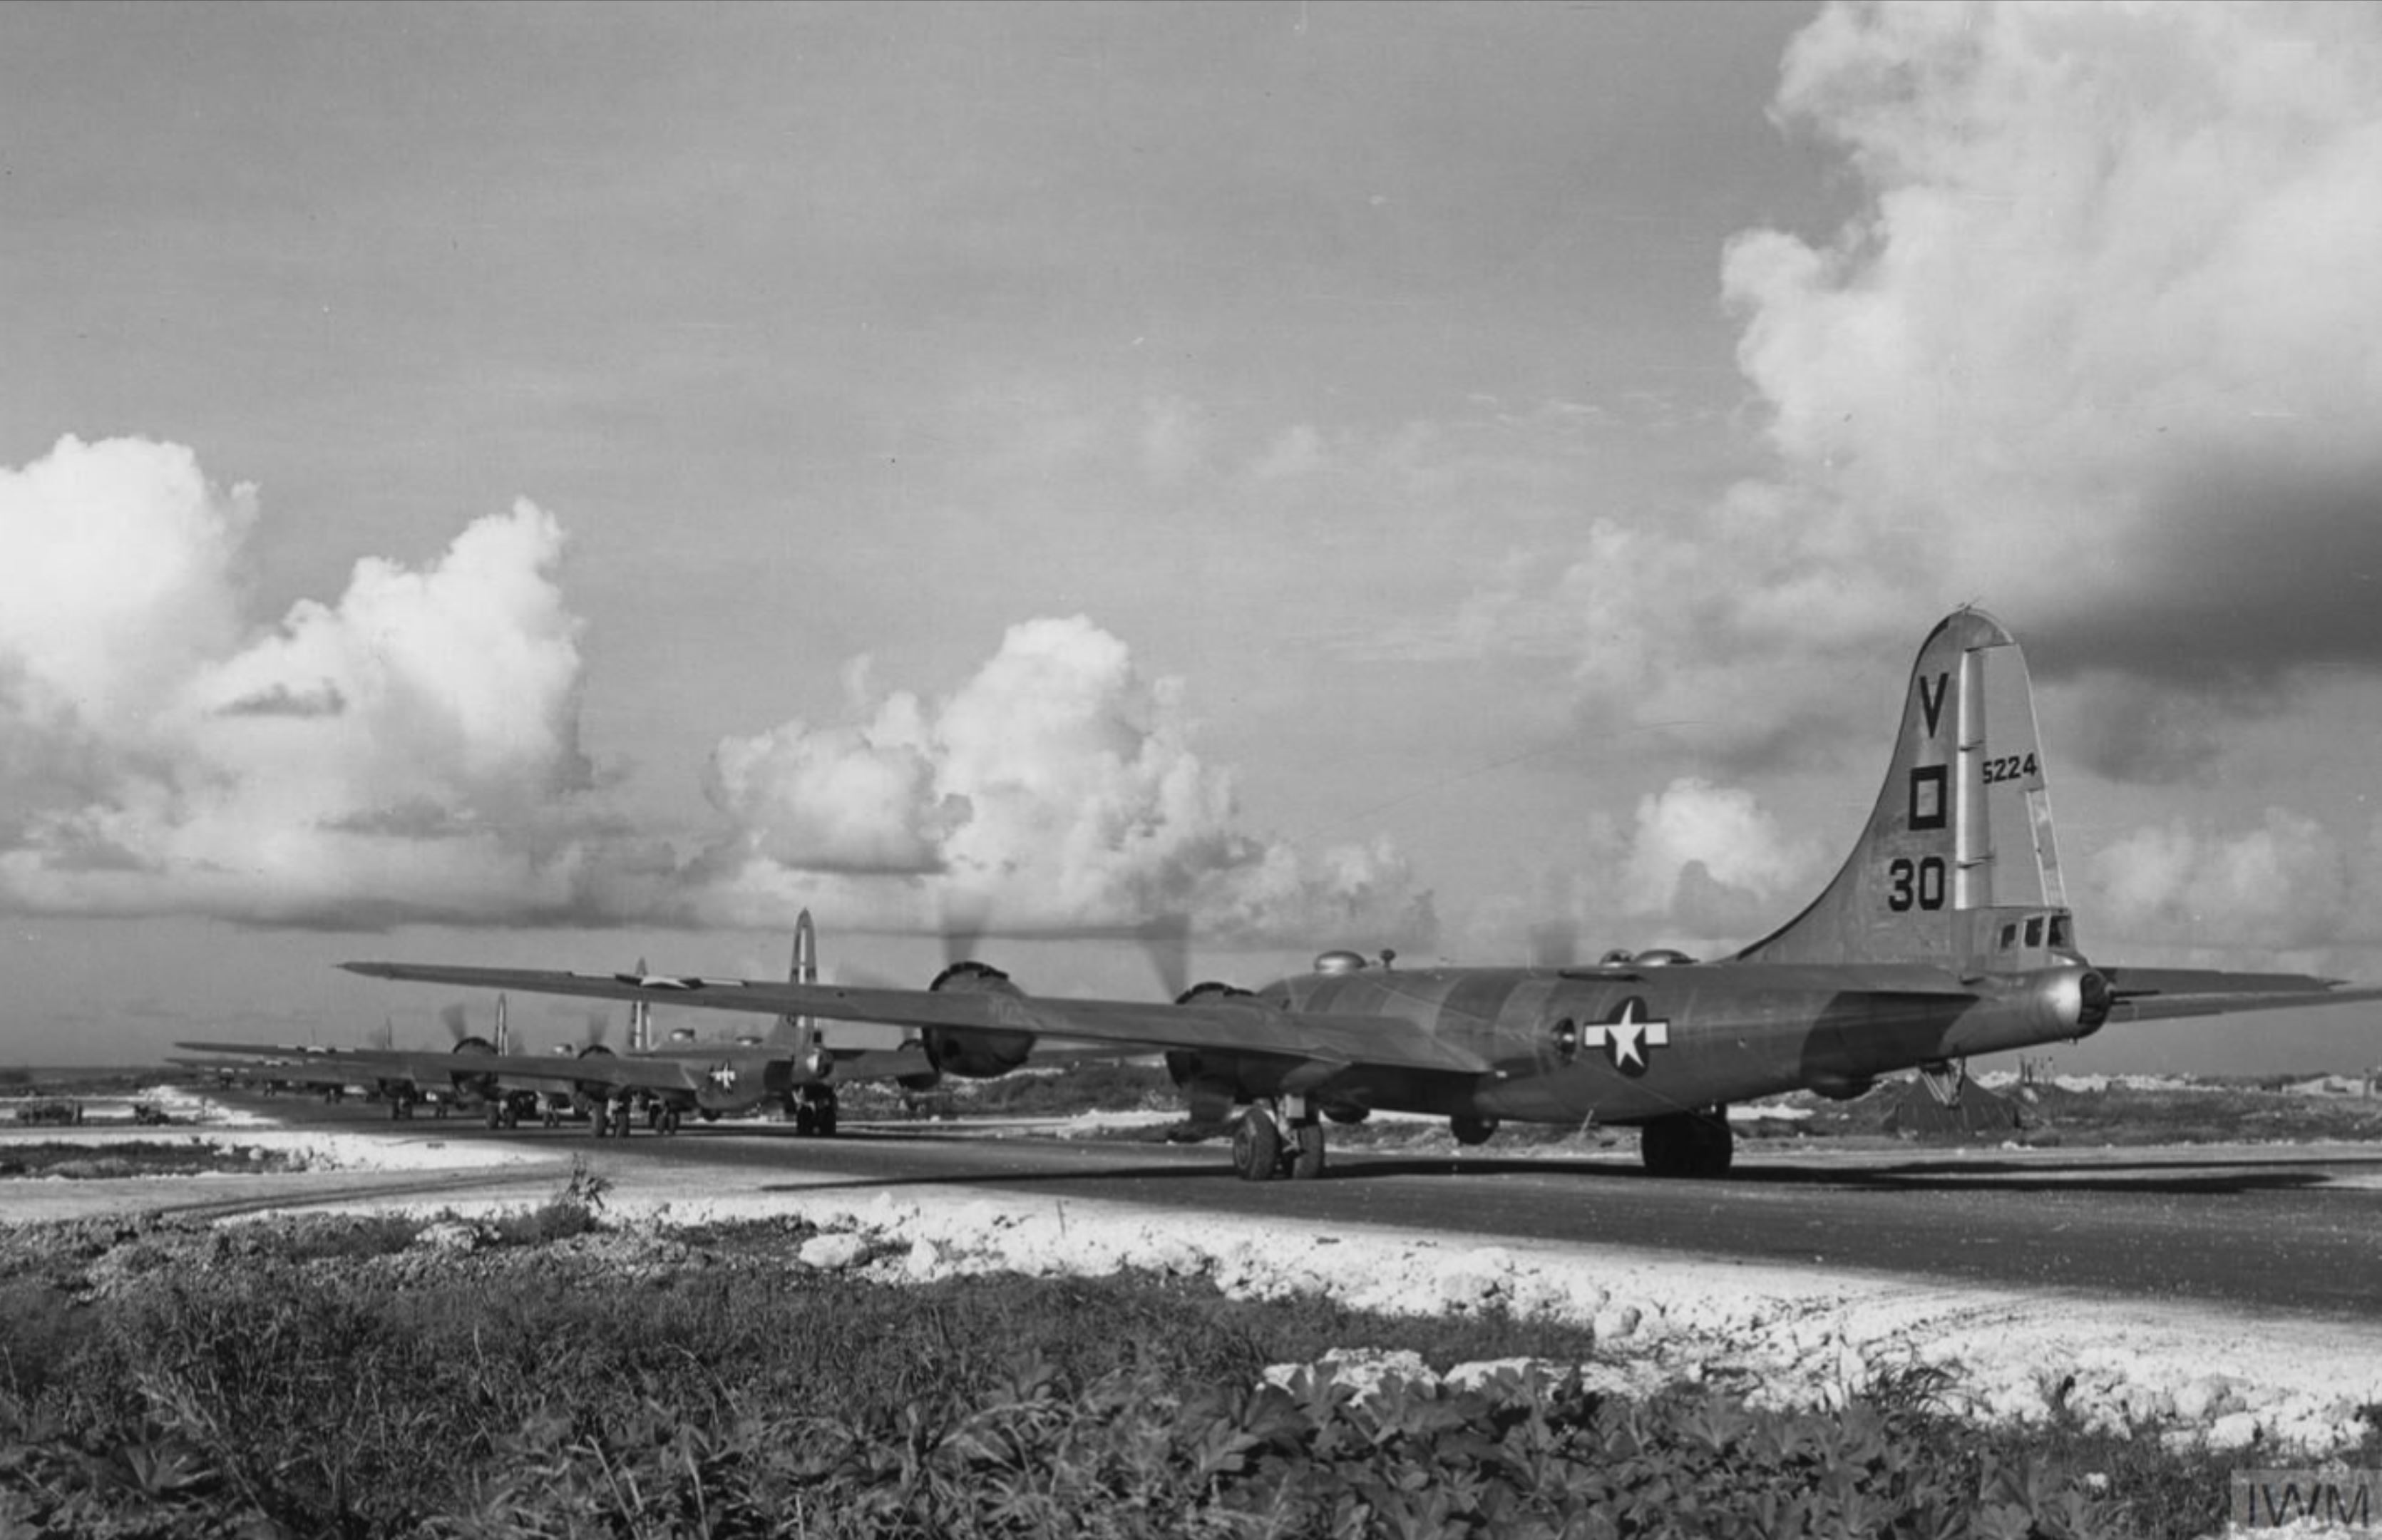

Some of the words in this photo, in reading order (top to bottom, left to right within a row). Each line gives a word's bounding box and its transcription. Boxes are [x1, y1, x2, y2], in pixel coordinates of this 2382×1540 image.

[1920, 672, 1949, 739] V
[1982, 752, 2037, 784] 5224
[1889, 857, 1945, 911] 30
